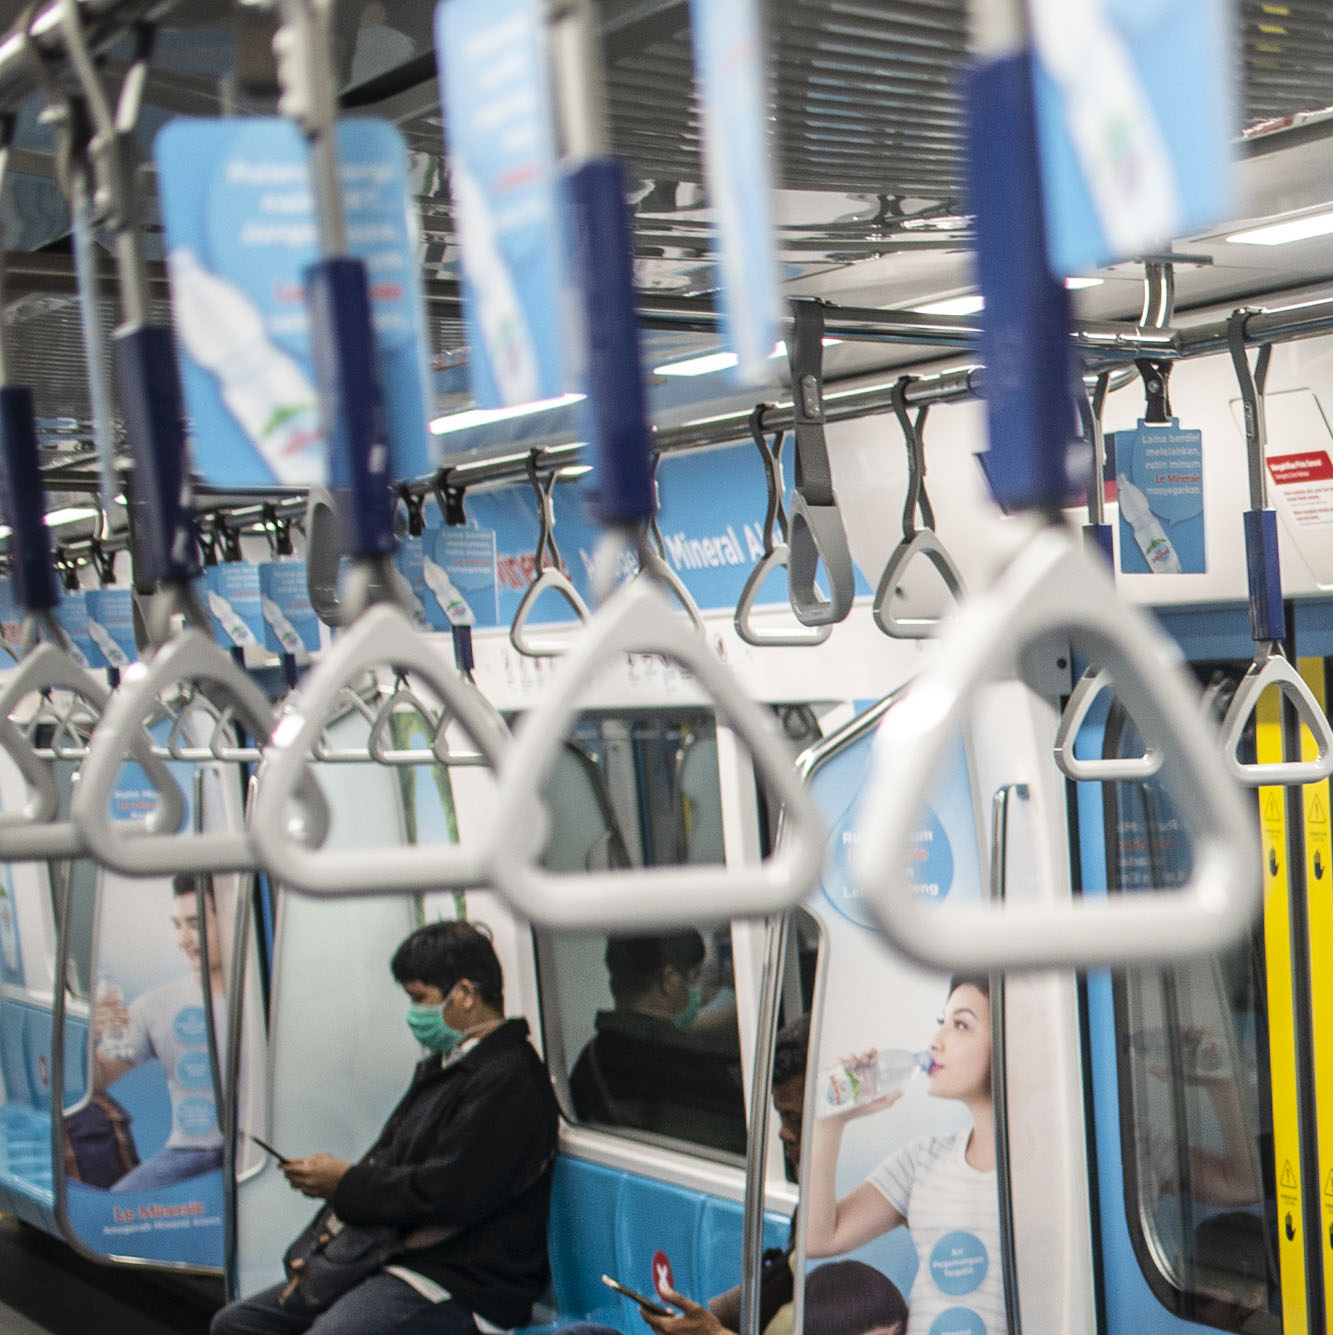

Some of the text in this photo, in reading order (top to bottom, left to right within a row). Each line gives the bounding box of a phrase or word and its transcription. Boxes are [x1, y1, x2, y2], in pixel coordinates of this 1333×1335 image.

[1142, 435, 1167, 444] Lama
[1155, 473, 1201, 484] Le Minerale
[664, 524, 744, 571] Mineral
[114, 1205, 135, 1222] Le
